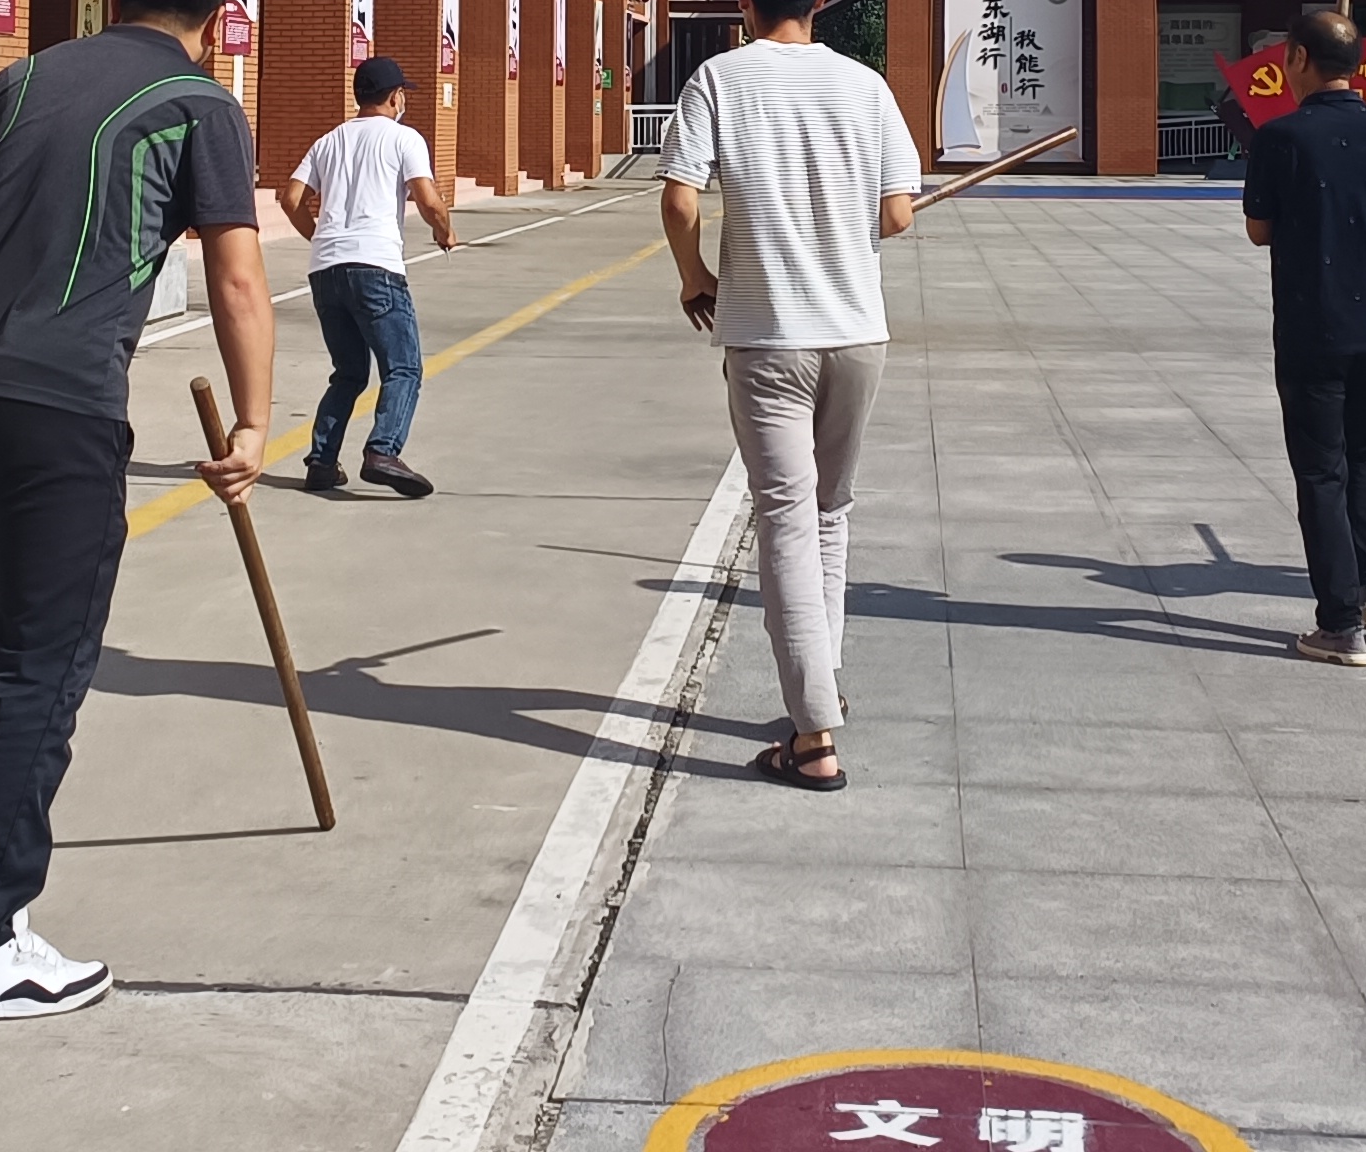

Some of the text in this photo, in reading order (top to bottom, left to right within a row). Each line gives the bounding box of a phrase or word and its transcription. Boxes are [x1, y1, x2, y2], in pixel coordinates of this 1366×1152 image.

[1014, 29, 1045, 99] 我能行
[828, 1100, 1087, 1152] 文明
